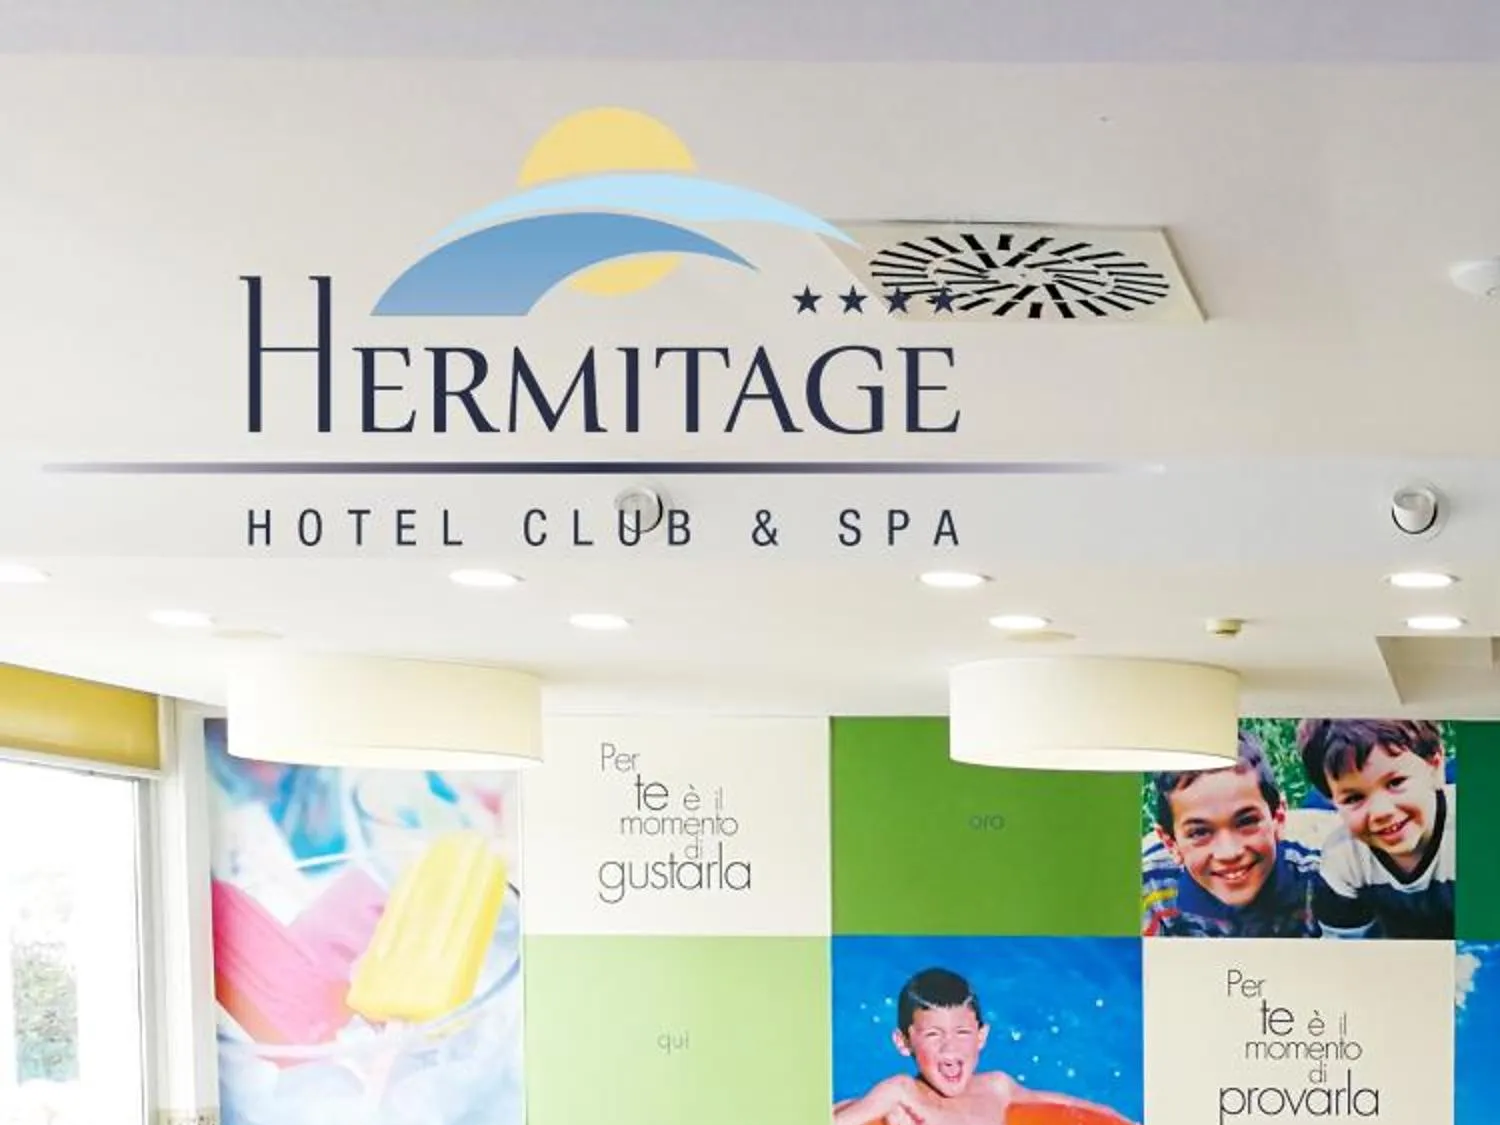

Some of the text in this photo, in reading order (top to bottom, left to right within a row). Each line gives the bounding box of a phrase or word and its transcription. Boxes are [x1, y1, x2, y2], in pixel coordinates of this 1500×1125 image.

[600, 742, 640, 772] Per
[634, 773, 724, 811] te è il
[620, 813, 739, 836] momento
[684, 835, 703, 860] di
[599, 842, 752, 904] gustarla
[1226, 968, 1266, 998] Per
[1260, 999, 1348, 1036] te è il
[656, 1029, 690, 1055] qui
[1245, 1038, 1363, 1061] momento
[1308, 1061, 1327, 1084] di
